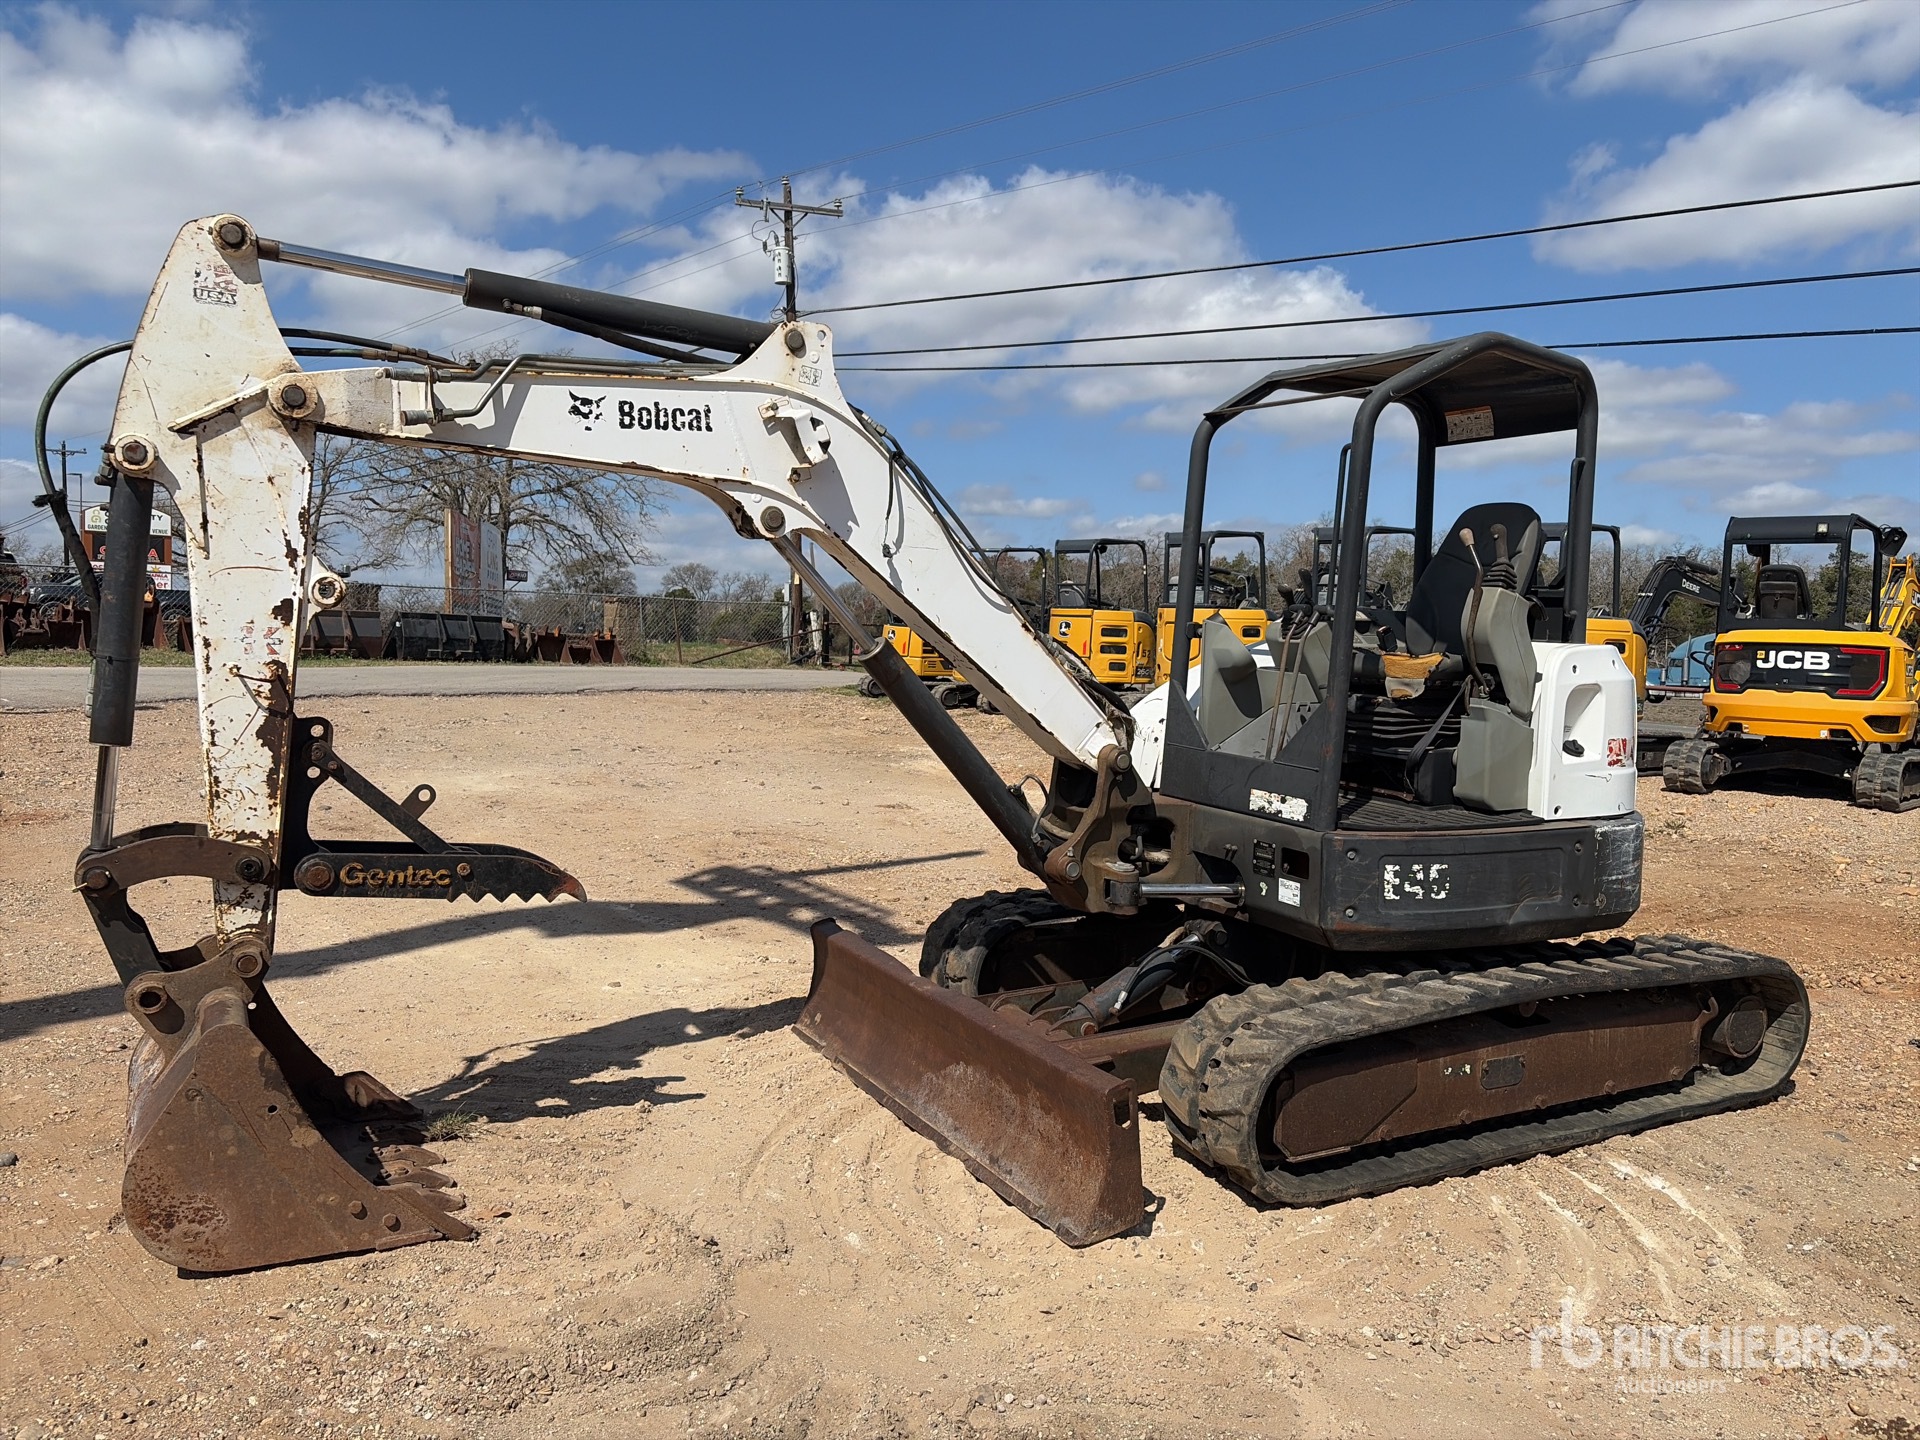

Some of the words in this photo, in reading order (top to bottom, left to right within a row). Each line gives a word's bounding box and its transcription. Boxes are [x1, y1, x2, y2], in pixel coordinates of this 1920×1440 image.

[618, 400, 714, 432] Bobcat
[1681, 578, 1701, 594] DEERE
[1756, 649, 1831, 671] JCB
